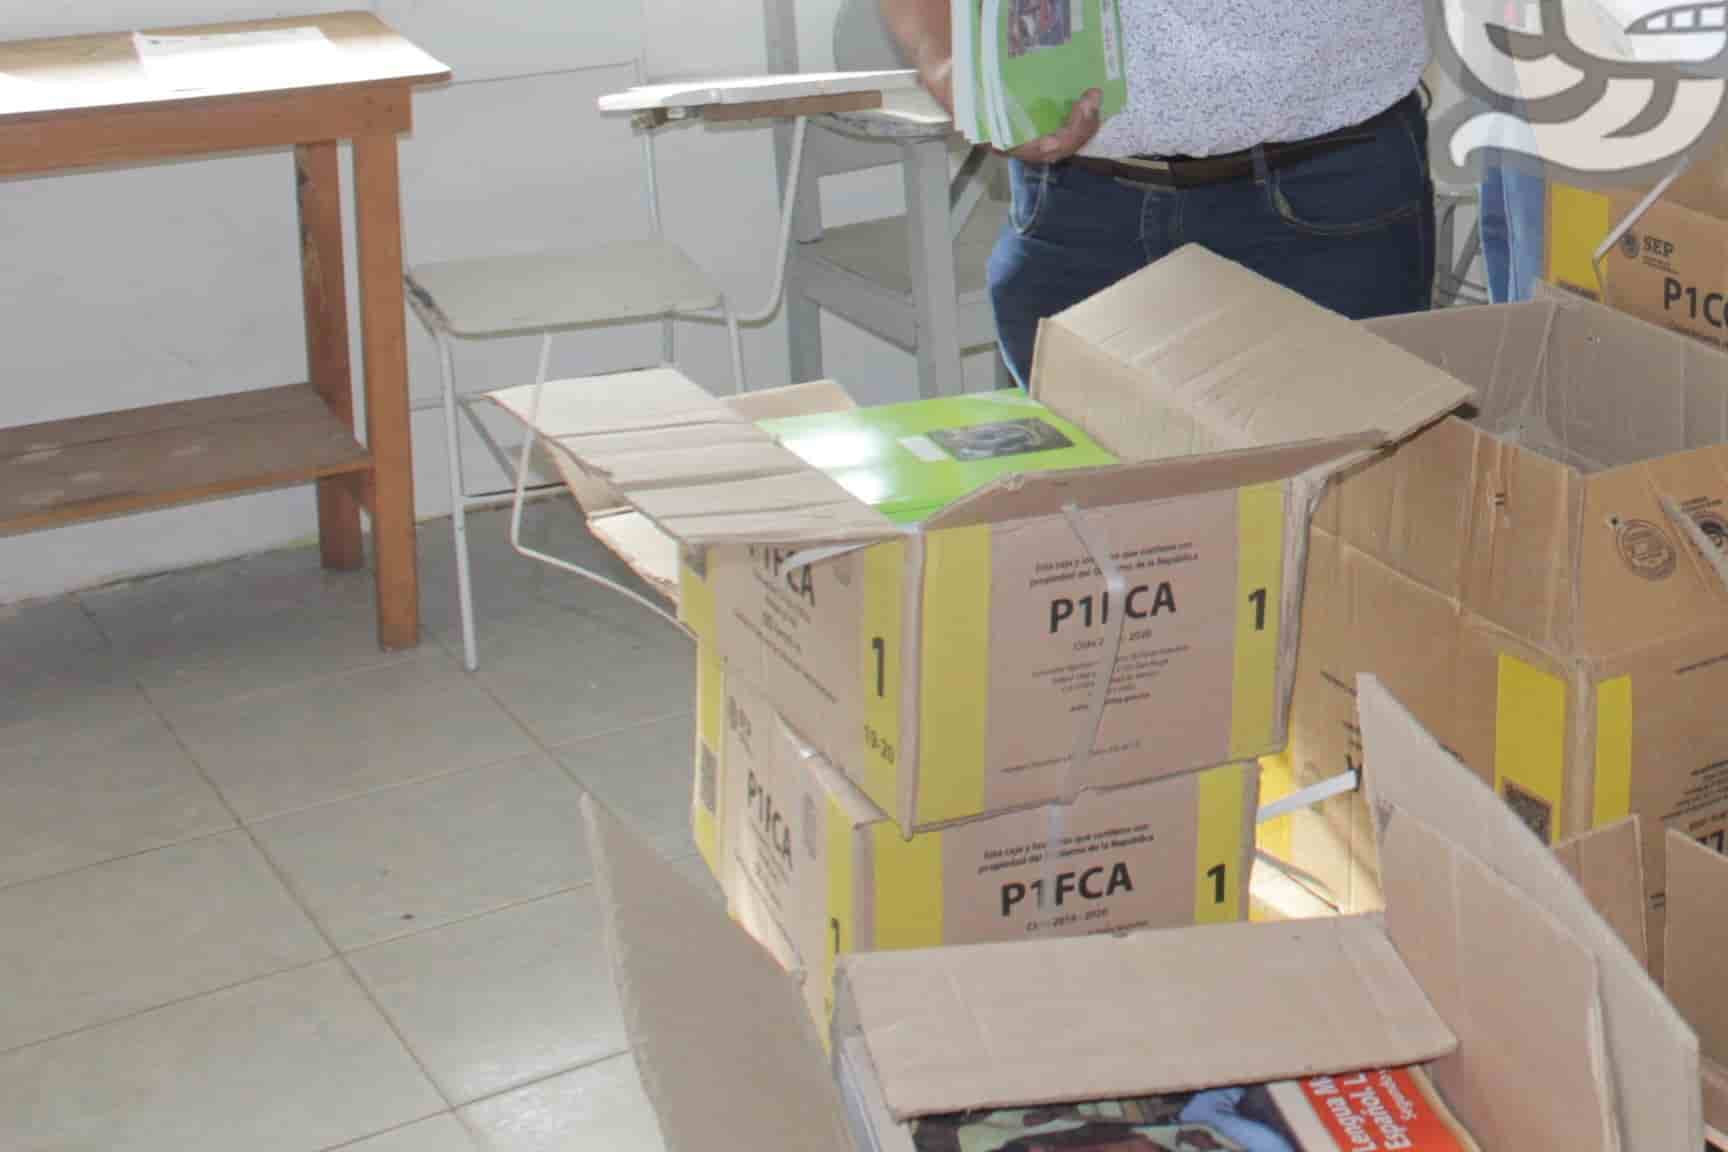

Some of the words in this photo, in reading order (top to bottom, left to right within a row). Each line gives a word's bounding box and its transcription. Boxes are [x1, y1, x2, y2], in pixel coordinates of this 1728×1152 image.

[1643, 235, 1674, 257] SEP
[1248, 586, 1268, 631] 1
[872, 636, 885, 698] 1
[1001, 861, 1134, 917] P1FCA
[1206, 862, 1227, 905] 1
